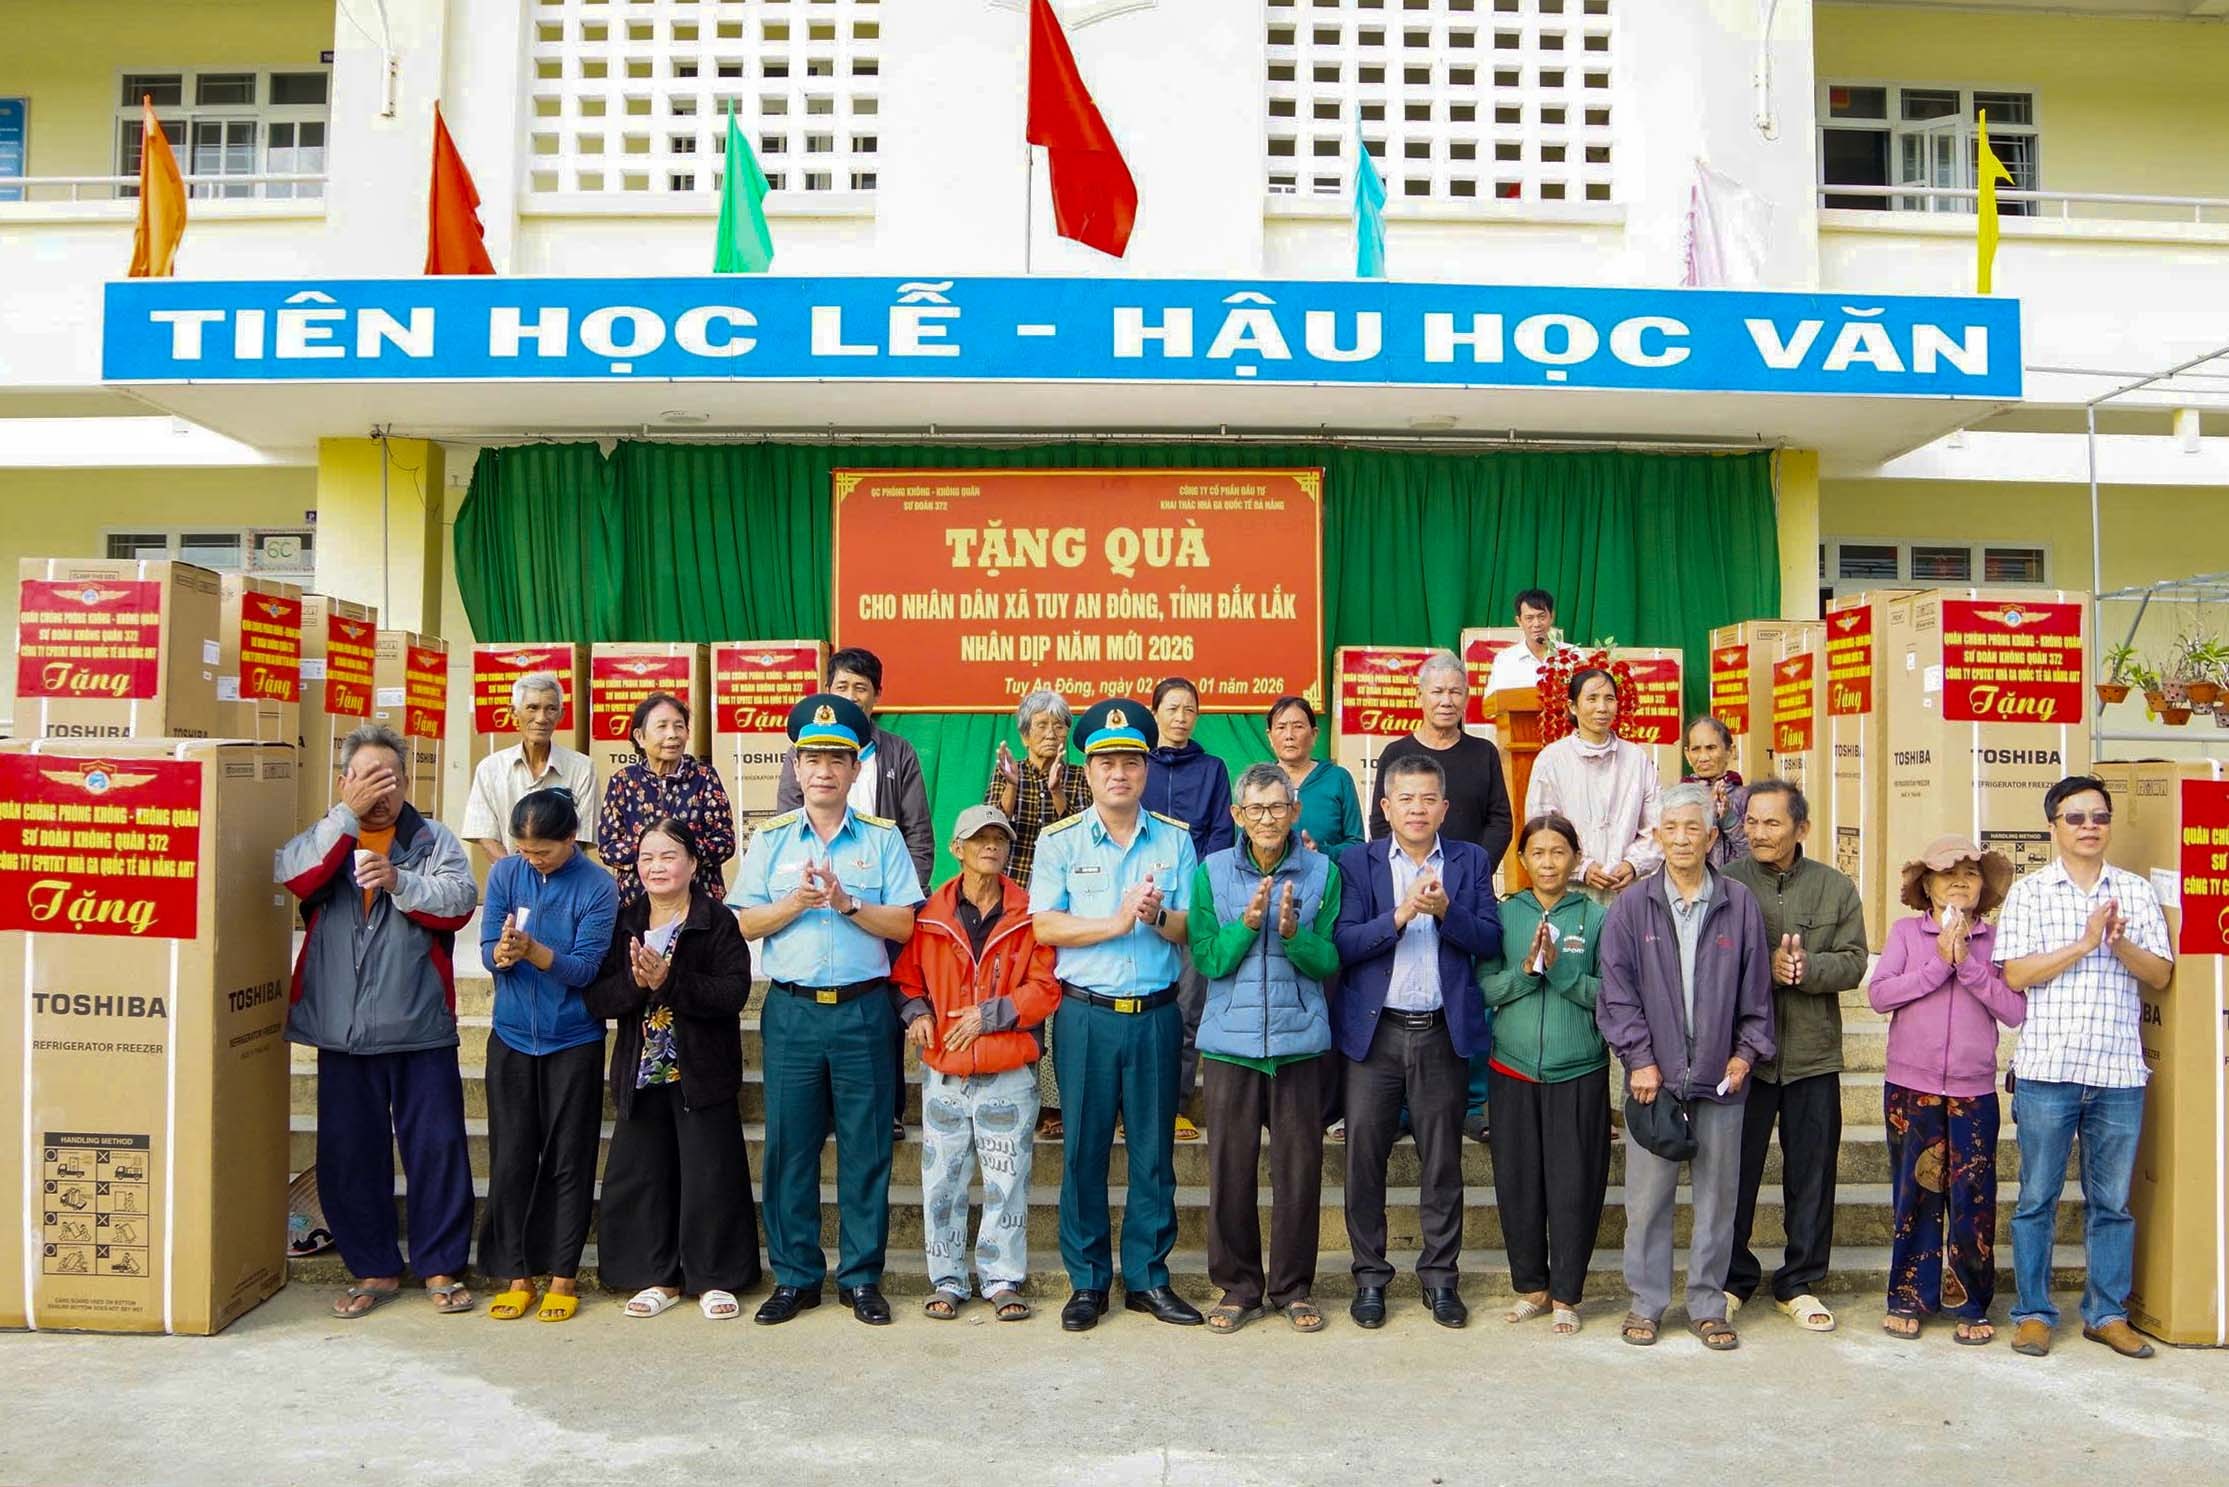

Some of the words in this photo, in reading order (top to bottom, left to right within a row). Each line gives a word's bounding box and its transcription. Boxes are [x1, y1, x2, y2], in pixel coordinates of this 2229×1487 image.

[151, 291, 435, 359] TIÊN
[490, 307, 758, 373] HỌC
[812, 281, 961, 357] LỄ
[1112, 291, 1382, 377] HẬU
[1425, 313, 1691, 381] HỌC
[1745, 305, 1988, 375] VĂN
[267, 541, 292, 558] 6C
[946, 519, 1087, 577] TẶNG
[1104, 518, 1211, 578] QUÀ
[859, 593, 897, 620] CHO
[902, 588, 954, 619] NHÂN
[960, 587, 999, 619] DÂN
[1004, 588, 1030, 619] XÃ
[1035, 592, 1069, 619] TUY
[1075, 592, 1101, 619] AN
[1106, 587, 1164, 621] ĐÔNG,
[1169, 584, 1212, 619] TỈNH
[1217, 583, 1256, 619] ĐẮK
[1261, 583, 1297, 619] LẮK
[961, 629, 1014, 661] NHÂN
[1019, 635, 1051, 667] DỊP
[1057, 629, 1101, 661] NĂM
[1106, 629, 1143, 661] MỚI
[1148, 635, 1194, 661] 2026
[43, 662, 130, 697] Tặng
[252, 667, 292, 699] Tặng
[1004, 678, 1031, 696] Tuy
[1031, 678, 1053, 693] An
[1055, 677, 1094, 697] Đông,
[1099, 678, 1133, 697] ngày
[1136, 678, 1153, 694] 02
[1199, 678, 1215, 694] 01
[1218, 678, 1249, 694] năm
[1252, 678, 1284, 694] 2026
[336, 685, 364, 714] Tặng
[1834, 683, 1862, 713] Tặng
[1969, 685, 2057, 721] Tặng
[46, 724, 131, 738] TOSHIBA
[412, 709, 438, 736] Tặng
[1780, 725, 1804, 750] Tặng
[1894, 750, 1931, 766] TOSHIBA
[0, 801, 21, 820] UÂN
[1990, 832, 2016, 840] HANDLING
[2017, 832, 2042, 840] METHOD
[2183, 825, 2209, 846] QUÂN
[0, 851, 19, 870] ÔNG
[2211, 852, 2228, 870] SƯ
[2184, 875, 2208, 895] CÔNG
[2210, 878, 2221, 896] TY
[28, 880, 158, 934] Tặng
[32, 993, 167, 1018] TOSHIBA
[228, 979, 283, 1013] TOSHIBA
[32, 1040, 114, 1052] REFRIGERATOR
[116, 1043, 163, 1054] FREEZER
[61, 1136, 100, 1145] HANDLING
[101, 1137, 133, 1146] METHOD
